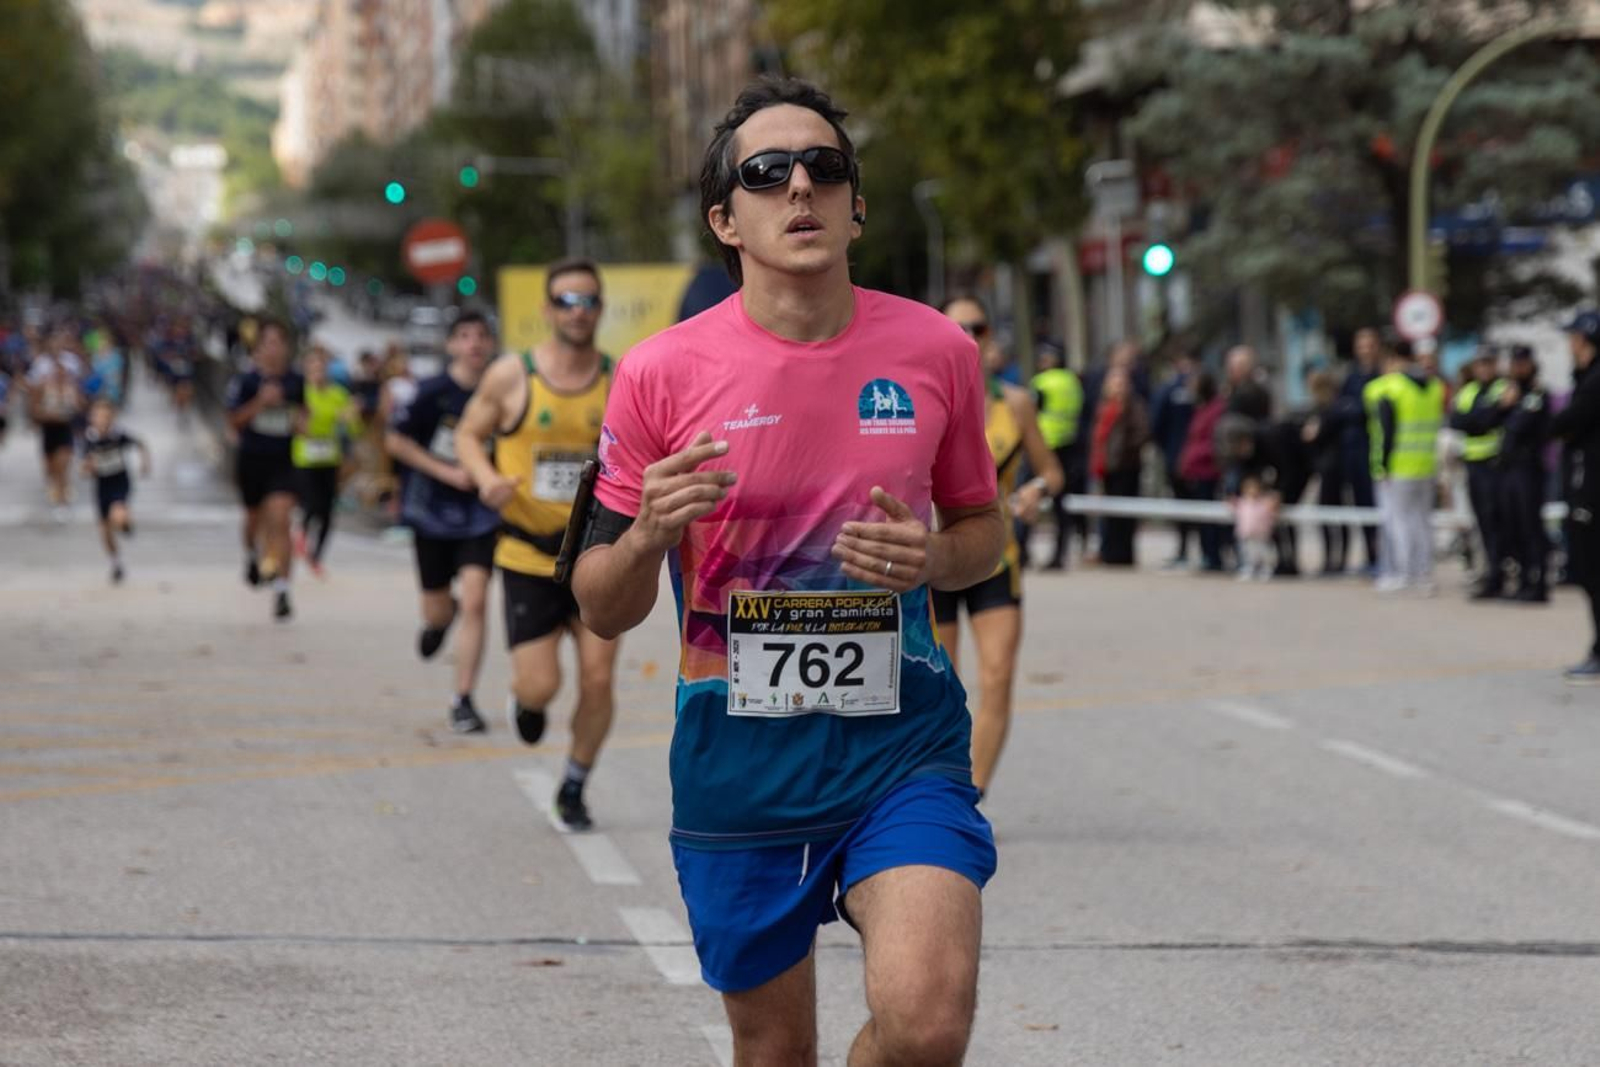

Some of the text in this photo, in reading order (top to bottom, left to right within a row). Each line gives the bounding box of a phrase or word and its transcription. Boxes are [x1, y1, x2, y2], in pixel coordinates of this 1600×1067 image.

[723, 414, 783, 430] TEAMERGY
[735, 596, 892, 619] XXV CARRERA POPULAR
[774, 606, 894, 620] y gran caminata
[771, 622, 784, 632] LA
[812, 622, 827, 632] LA
[763, 640, 864, 688] 762
